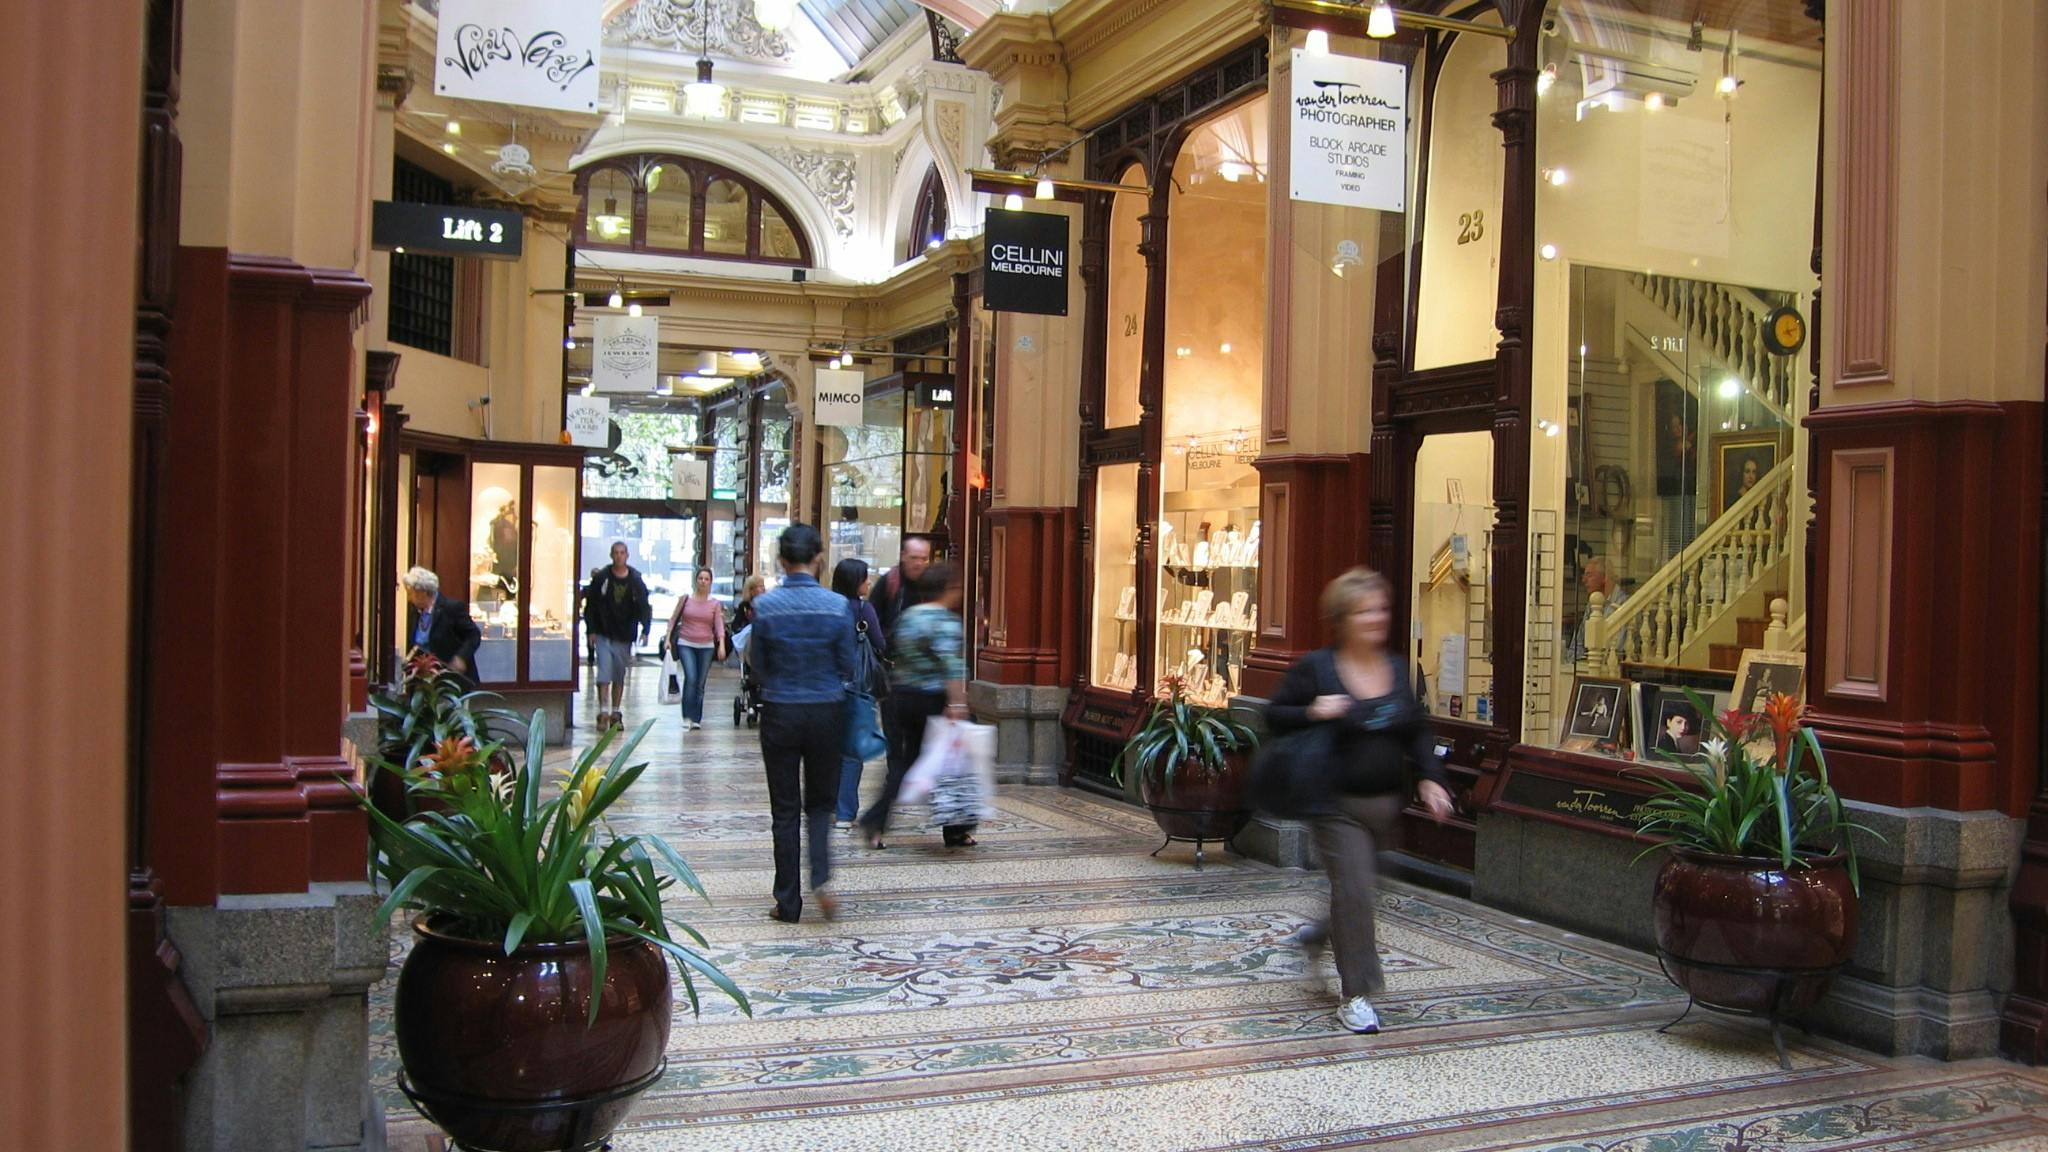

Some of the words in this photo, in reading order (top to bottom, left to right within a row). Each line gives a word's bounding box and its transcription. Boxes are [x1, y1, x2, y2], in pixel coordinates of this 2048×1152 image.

[444, 24, 512, 80] Very
[1300, 107, 1396, 132] PHOTOGRAPHER
[1309, 136, 1344, 151] BLOCK
[1348, 141, 1387, 156] ARCADE
[1328, 152, 1370, 168] STUDIOS
[1335, 169, 1366, 180] FRAMING
[1341, 183, 1361, 192] VIDEO
[442, 217, 483, 241] Lift
[489, 222, 503, 243] 2
[1457, 209, 1484, 246] 23
[991, 244, 1063, 266] CELLINI
[991, 261, 1062, 277] MELBOURNE
[1125, 313, 1137, 337] 24
[818, 391, 861, 406] MIMCO
